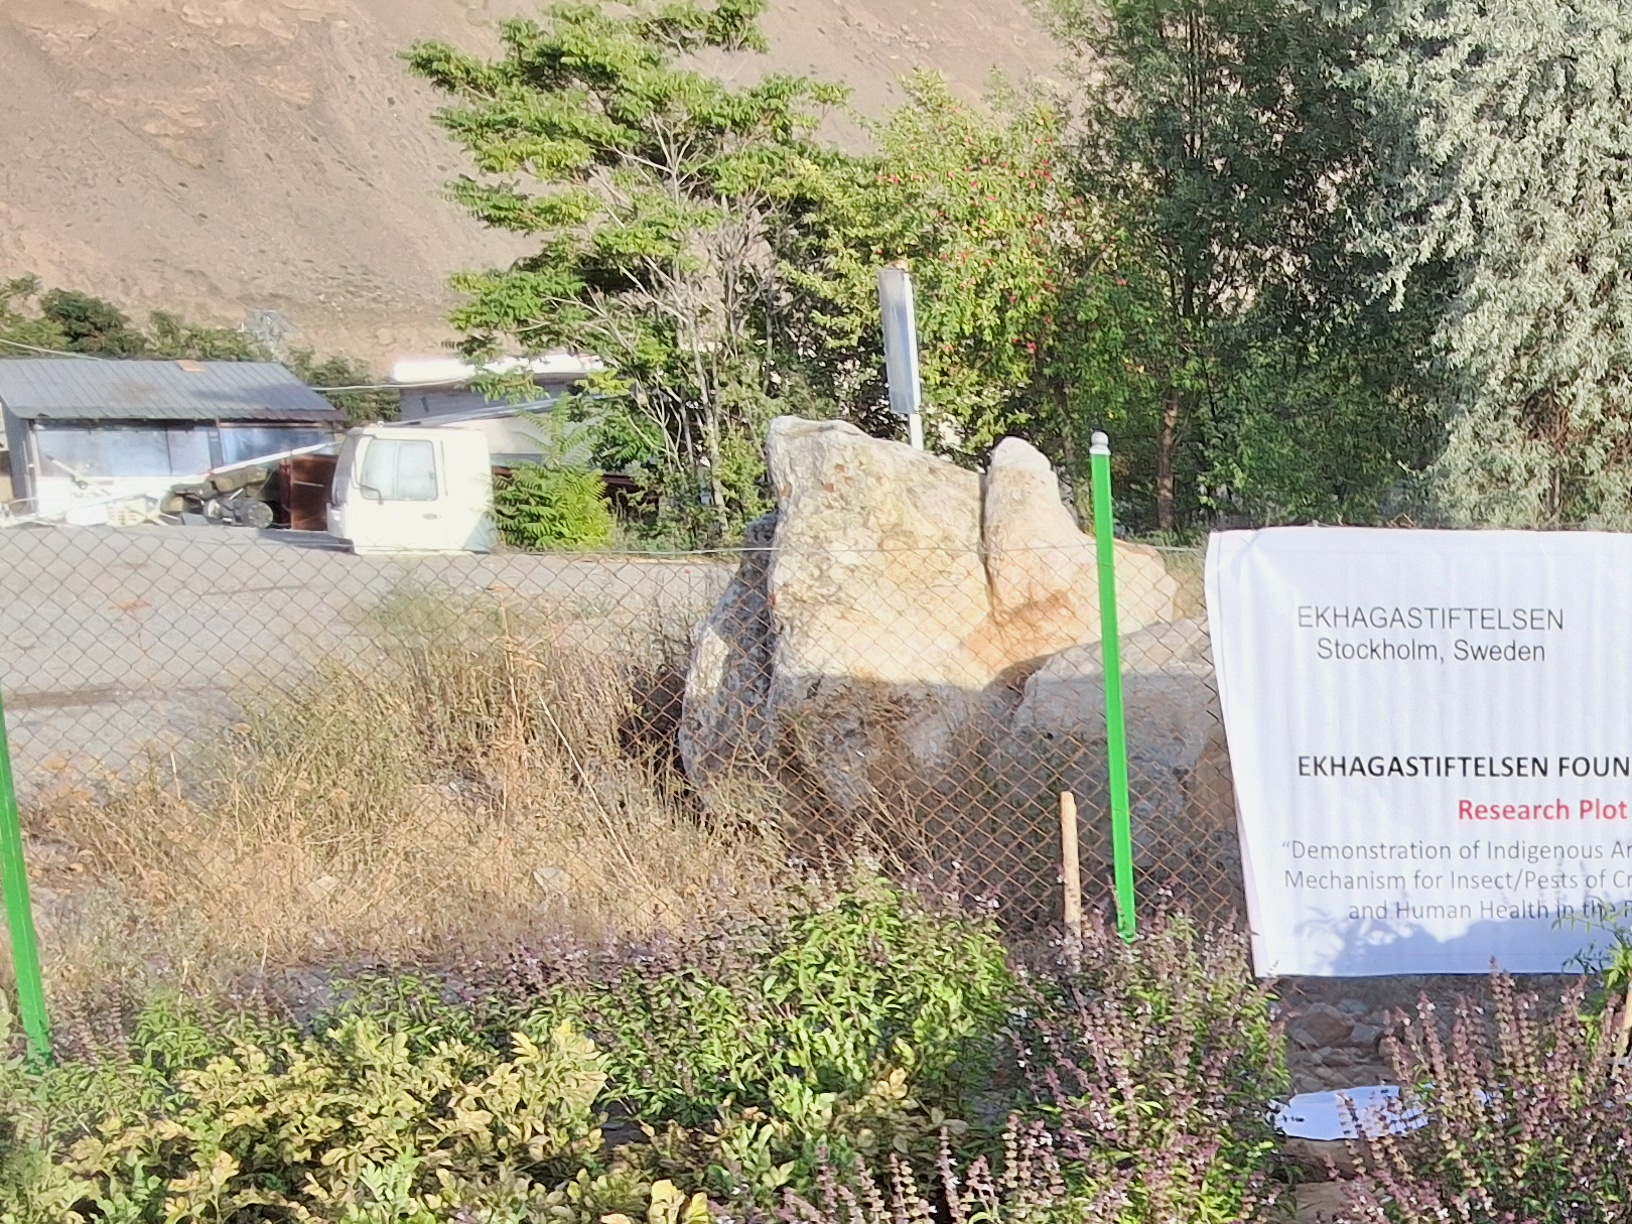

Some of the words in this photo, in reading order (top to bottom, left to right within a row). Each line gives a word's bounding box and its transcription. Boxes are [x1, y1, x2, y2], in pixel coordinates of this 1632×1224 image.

[1298, 605, 1564, 630] EKHAGASTIFTELSEN
[1317, 637, 1444, 663] Stockholm,
[1453, 639, 1545, 661] Sweden
[1298, 755, 1549, 778] EKHAGASTIFTELSEN
[1458, 798, 1569, 820] Research
[1579, 798, 1628, 820] Plot
[1459, 839, 1481, 860] of
[1487, 839, 1603, 864] Indigenous
[1285, 869, 1406, 890] Mechanism
[1414, 869, 1443, 890] for
[1451, 869, 1578, 892] Insect/Pests
[1586, 868, 1607, 889] of
[1349, 900, 1388, 920] and
[1396, 900, 1472, 920] Human
[1480, 899, 1549, 920] Health
[1556, 897, 1575, 919] in
